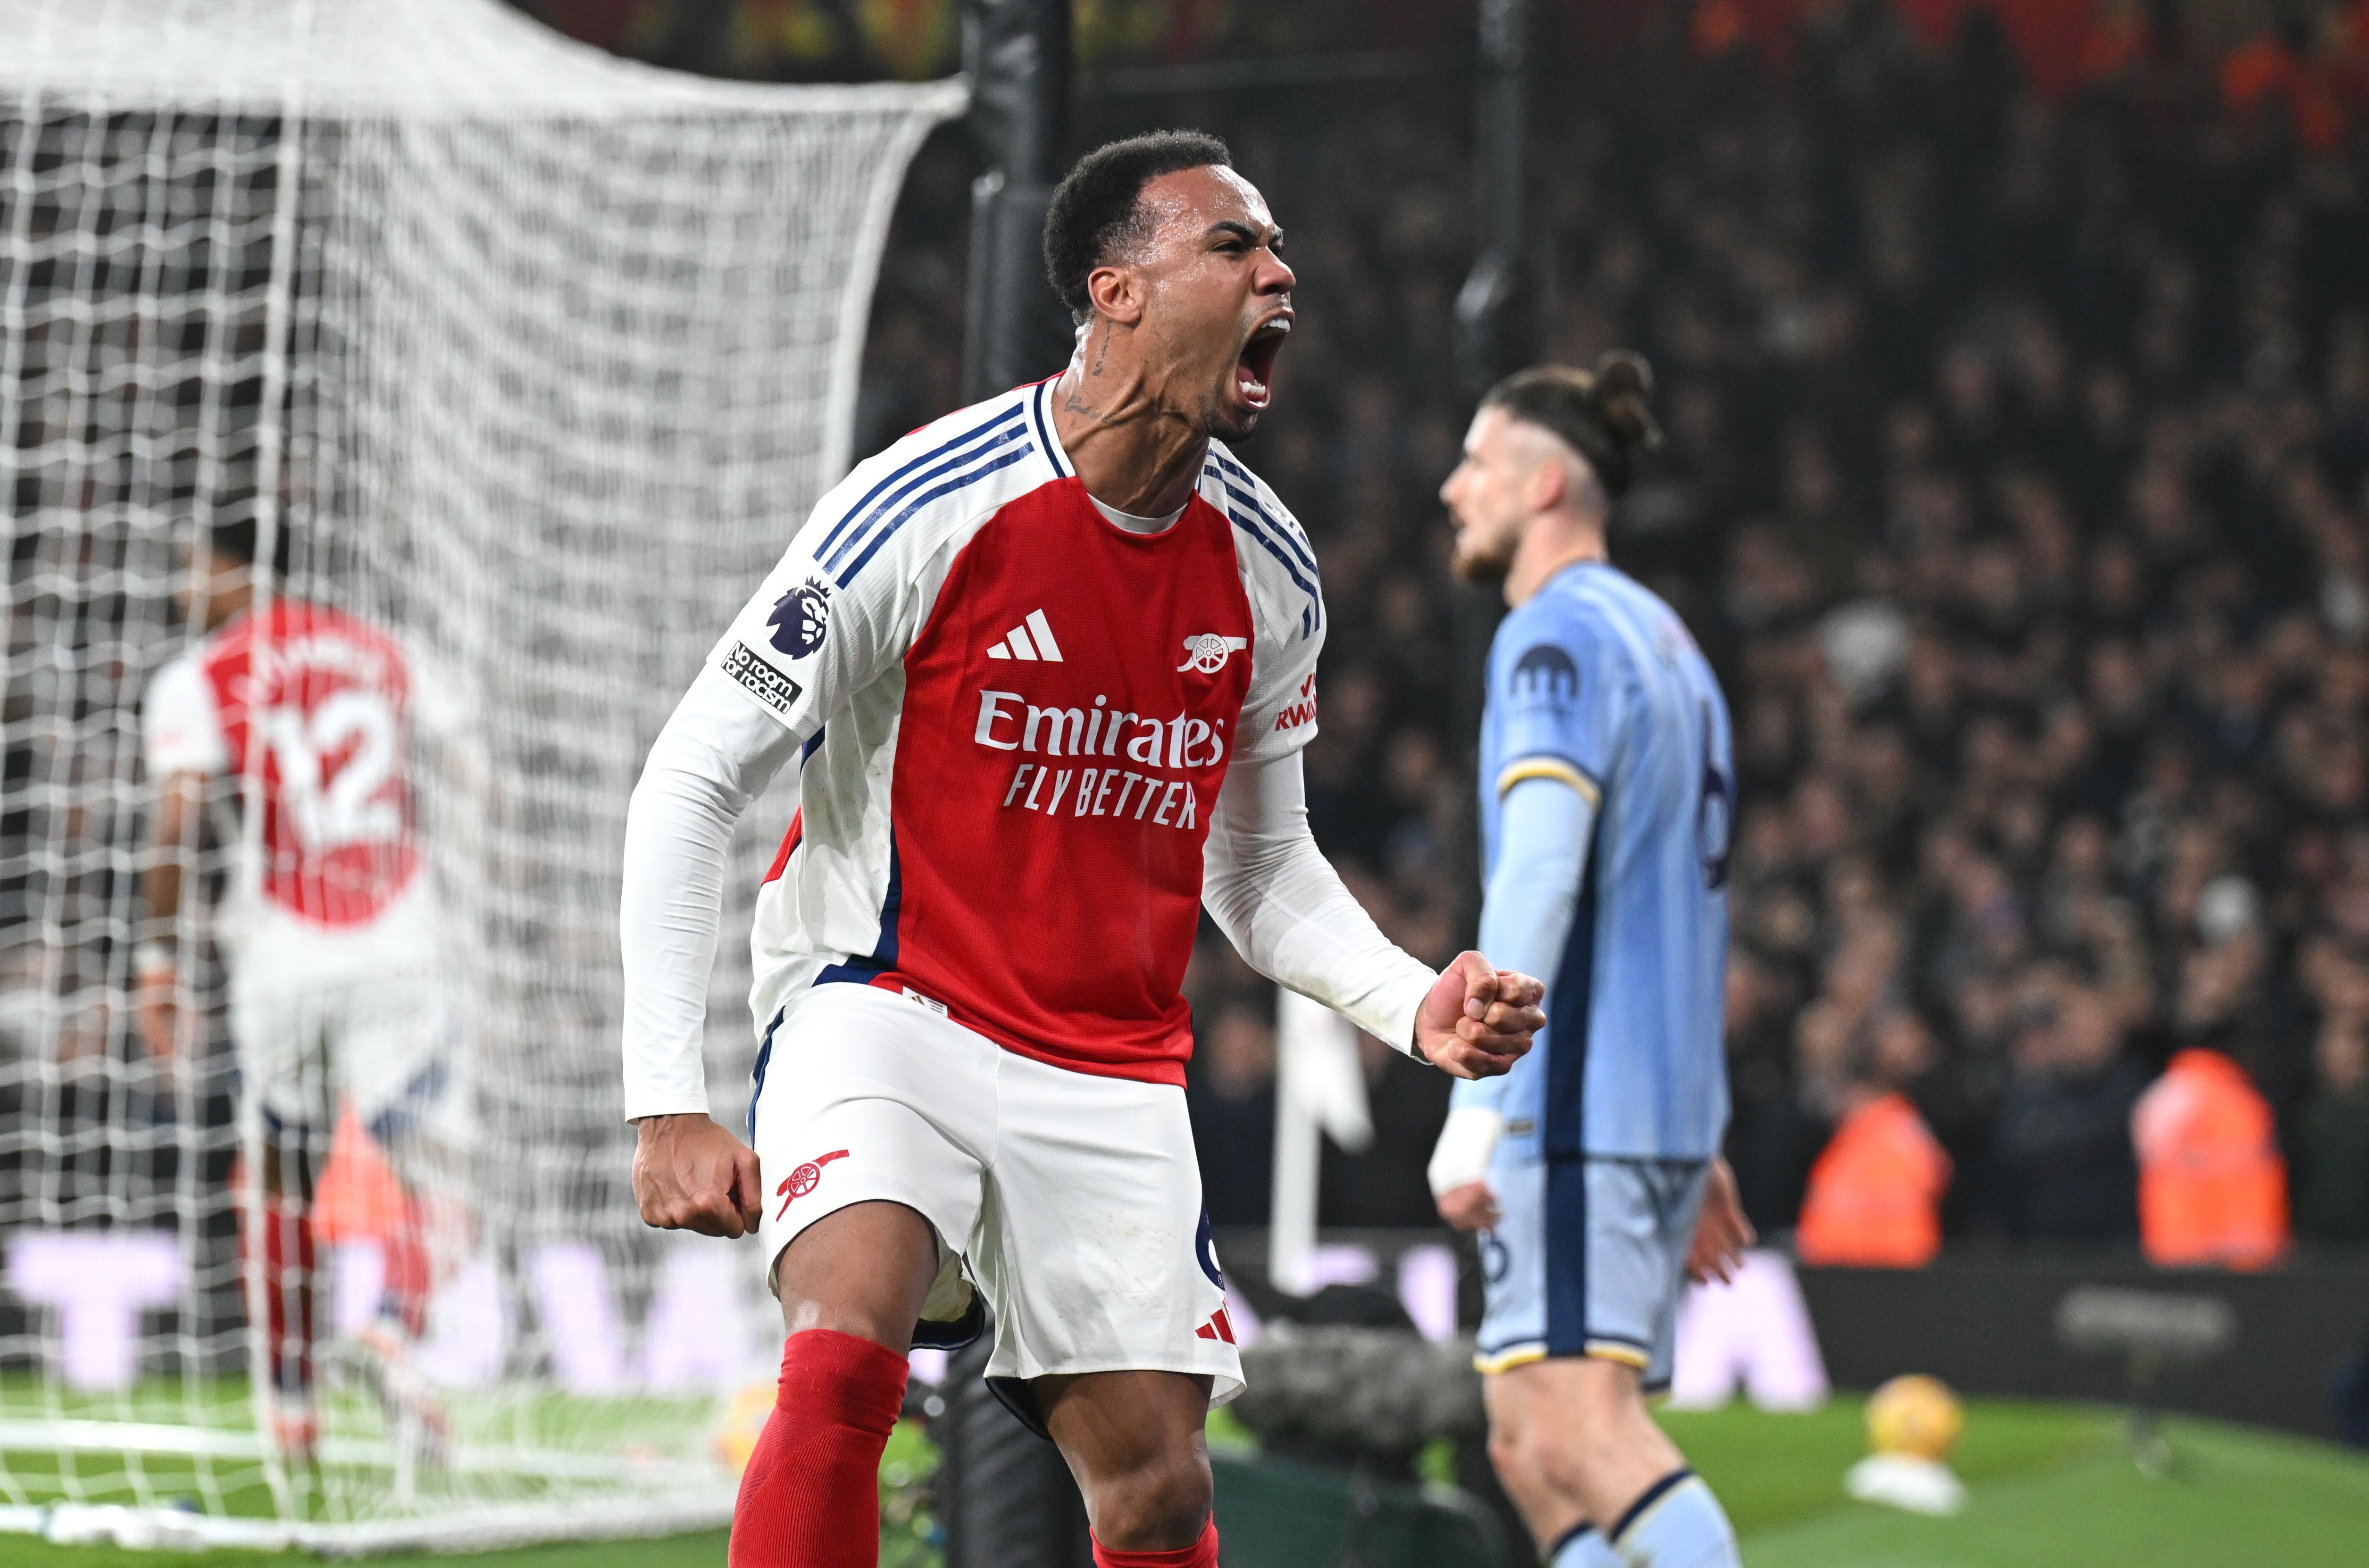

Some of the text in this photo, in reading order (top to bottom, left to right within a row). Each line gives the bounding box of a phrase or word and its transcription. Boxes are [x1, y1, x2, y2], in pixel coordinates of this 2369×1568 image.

[721, 653, 791, 714] for racism
[729, 640, 793, 698] No room
[974, 689, 1224, 769] Emirates
[260, 691, 402, 855] 12
[1003, 764, 1196, 830] FLY BETTER
